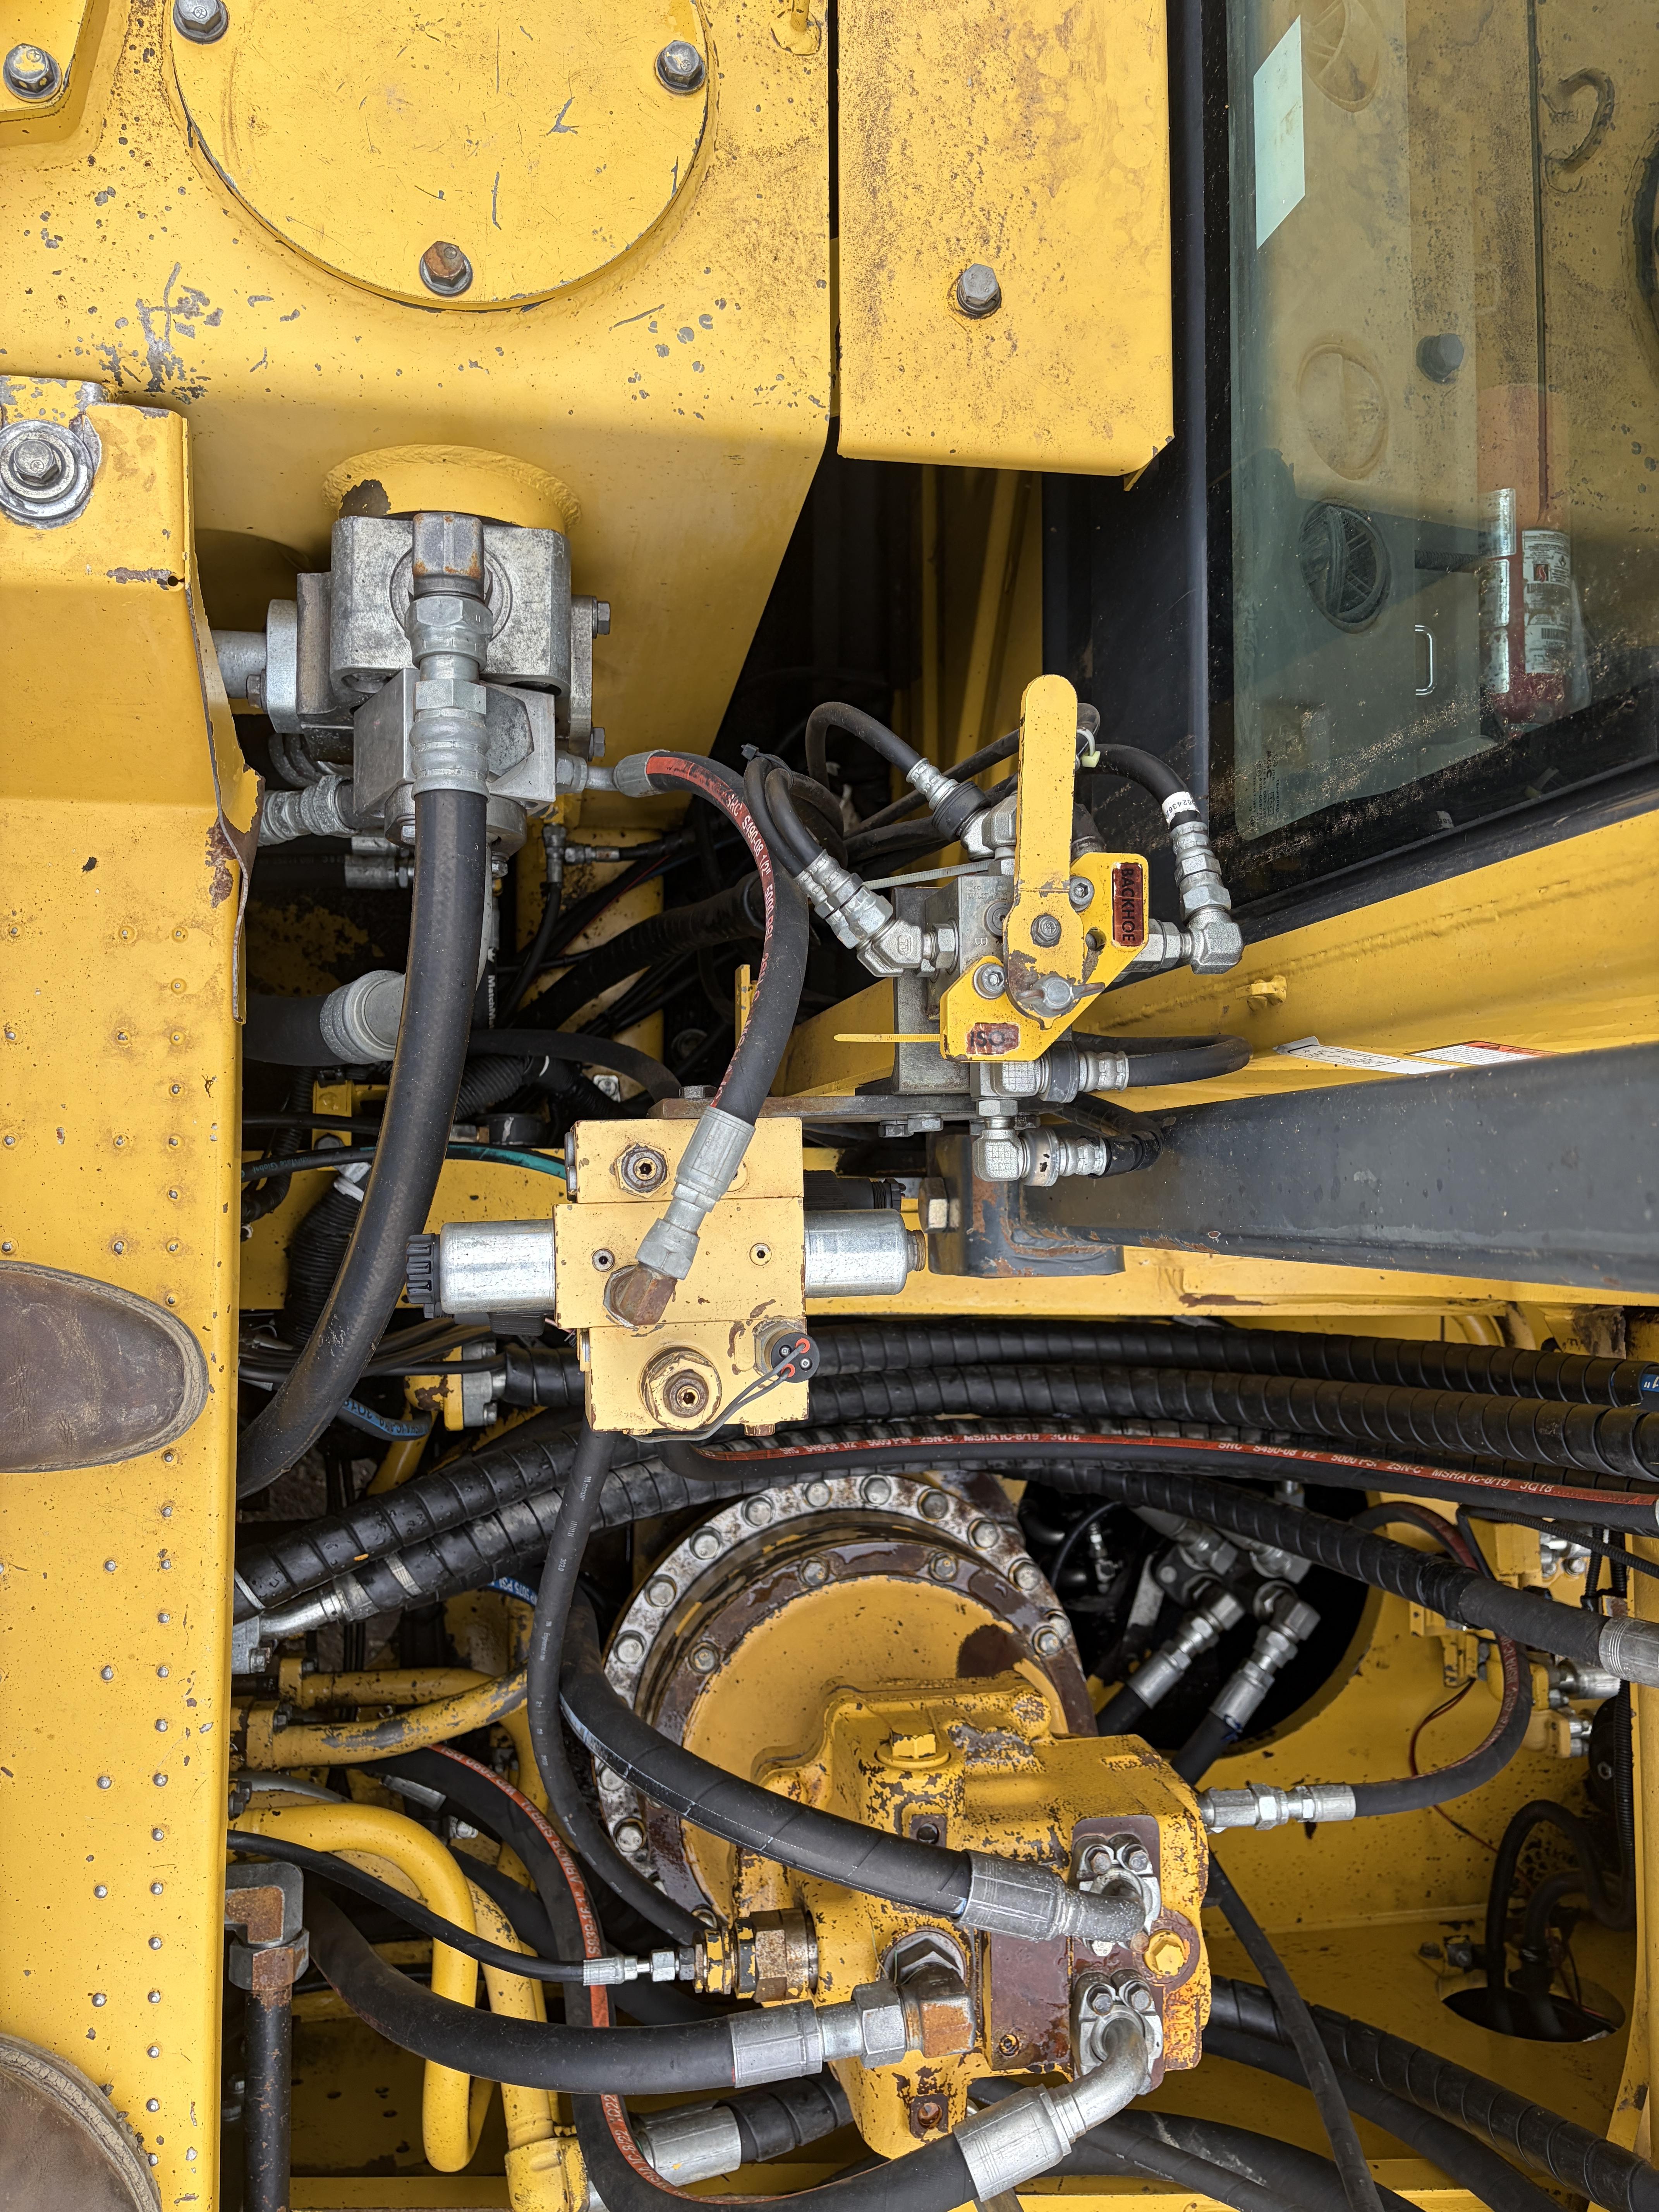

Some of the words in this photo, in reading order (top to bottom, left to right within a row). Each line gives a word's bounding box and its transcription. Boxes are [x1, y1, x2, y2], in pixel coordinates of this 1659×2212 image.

[742, 815, 764, 857] S490-08
[759, 854, 771, 877] 1/2"
[1121, 868, 1135, 941] BACKHOE
[970, 1030, 1005, 1048] ISO
